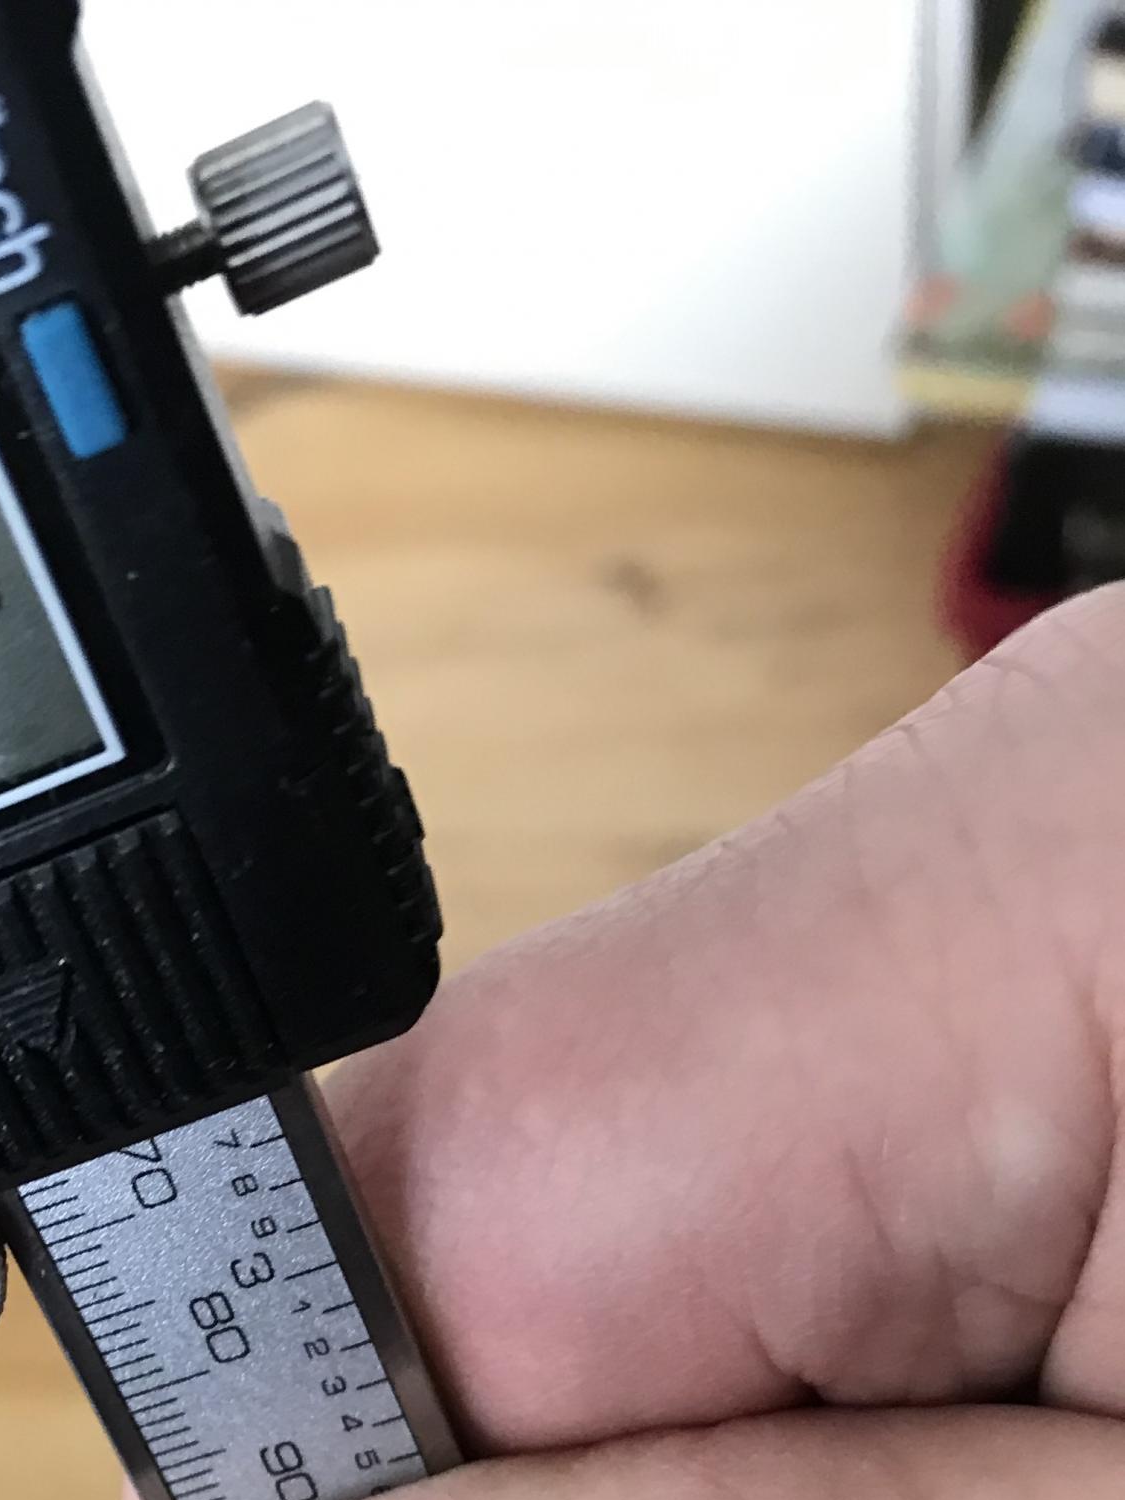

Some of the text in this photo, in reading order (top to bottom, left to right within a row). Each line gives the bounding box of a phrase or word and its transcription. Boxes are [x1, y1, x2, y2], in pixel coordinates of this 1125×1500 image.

[231, 1173, 259, 1197] 8
[251, 1214, 277, 1239] 9
[230, 1252, 275, 1288] 3
[188, 1290, 251, 1364] 80
[303, 1337, 330, 1360] 2
[321, 1376, 348, 1398] 3
[340, 1413, 364, 1433] 4
[354, 1448, 381, 1470] 5
